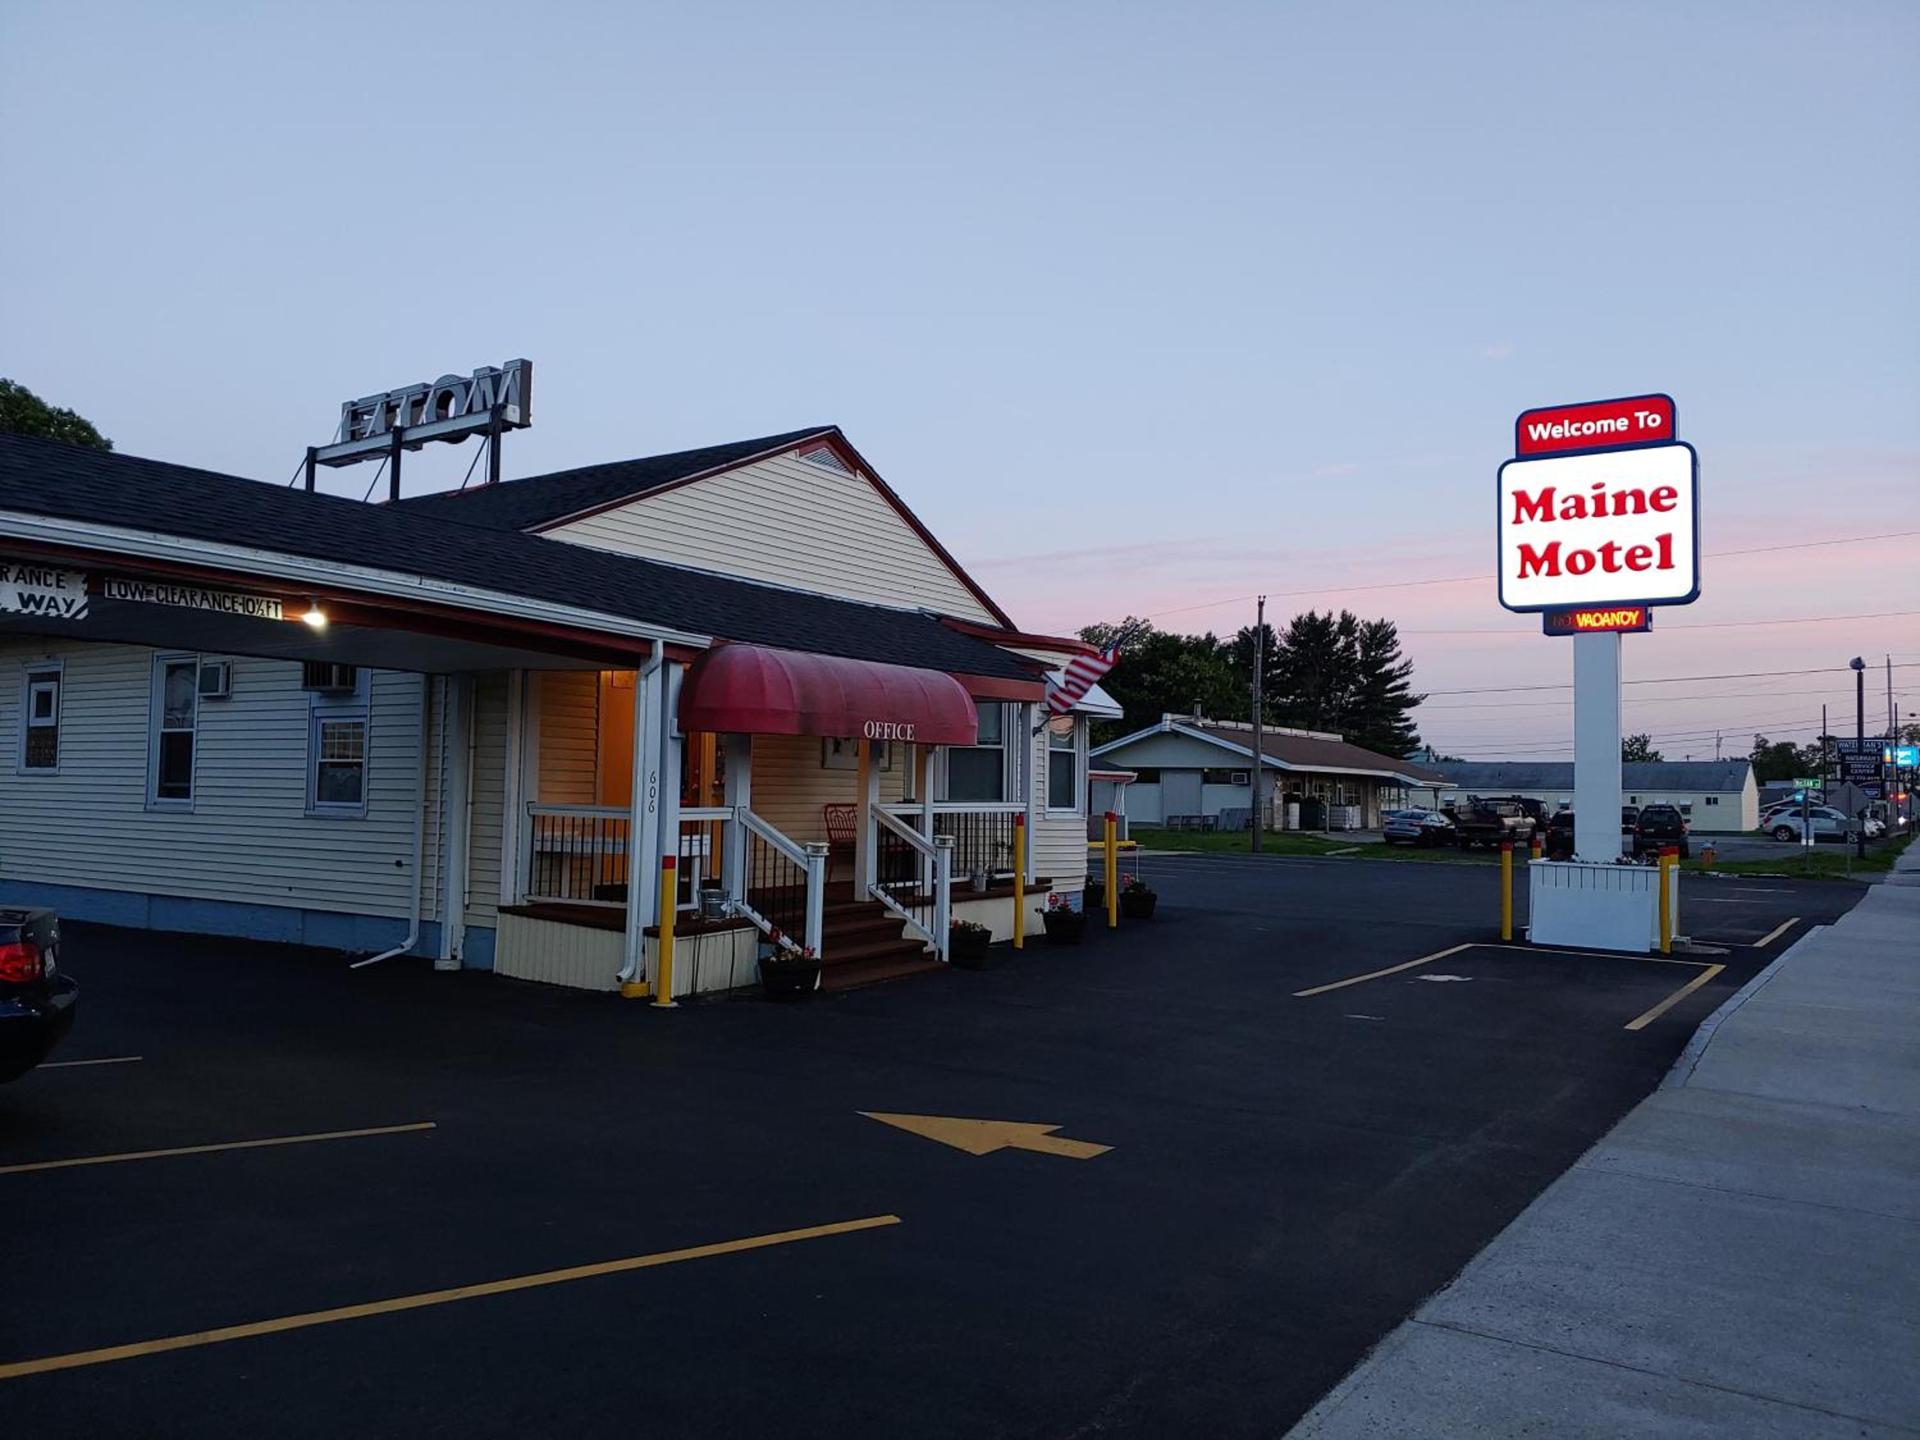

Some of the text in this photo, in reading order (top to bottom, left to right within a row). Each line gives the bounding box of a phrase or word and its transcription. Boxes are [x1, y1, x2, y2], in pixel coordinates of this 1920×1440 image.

[1528, 411, 1662, 441] Welcome To
[1511, 482, 1679, 525] Maine
[1516, 533, 1676, 580] Motel
[17, 592, 76, 614] WAY
[1575, 610, 1640, 628] VACANCY
[863, 720, 915, 741] OFFICE
